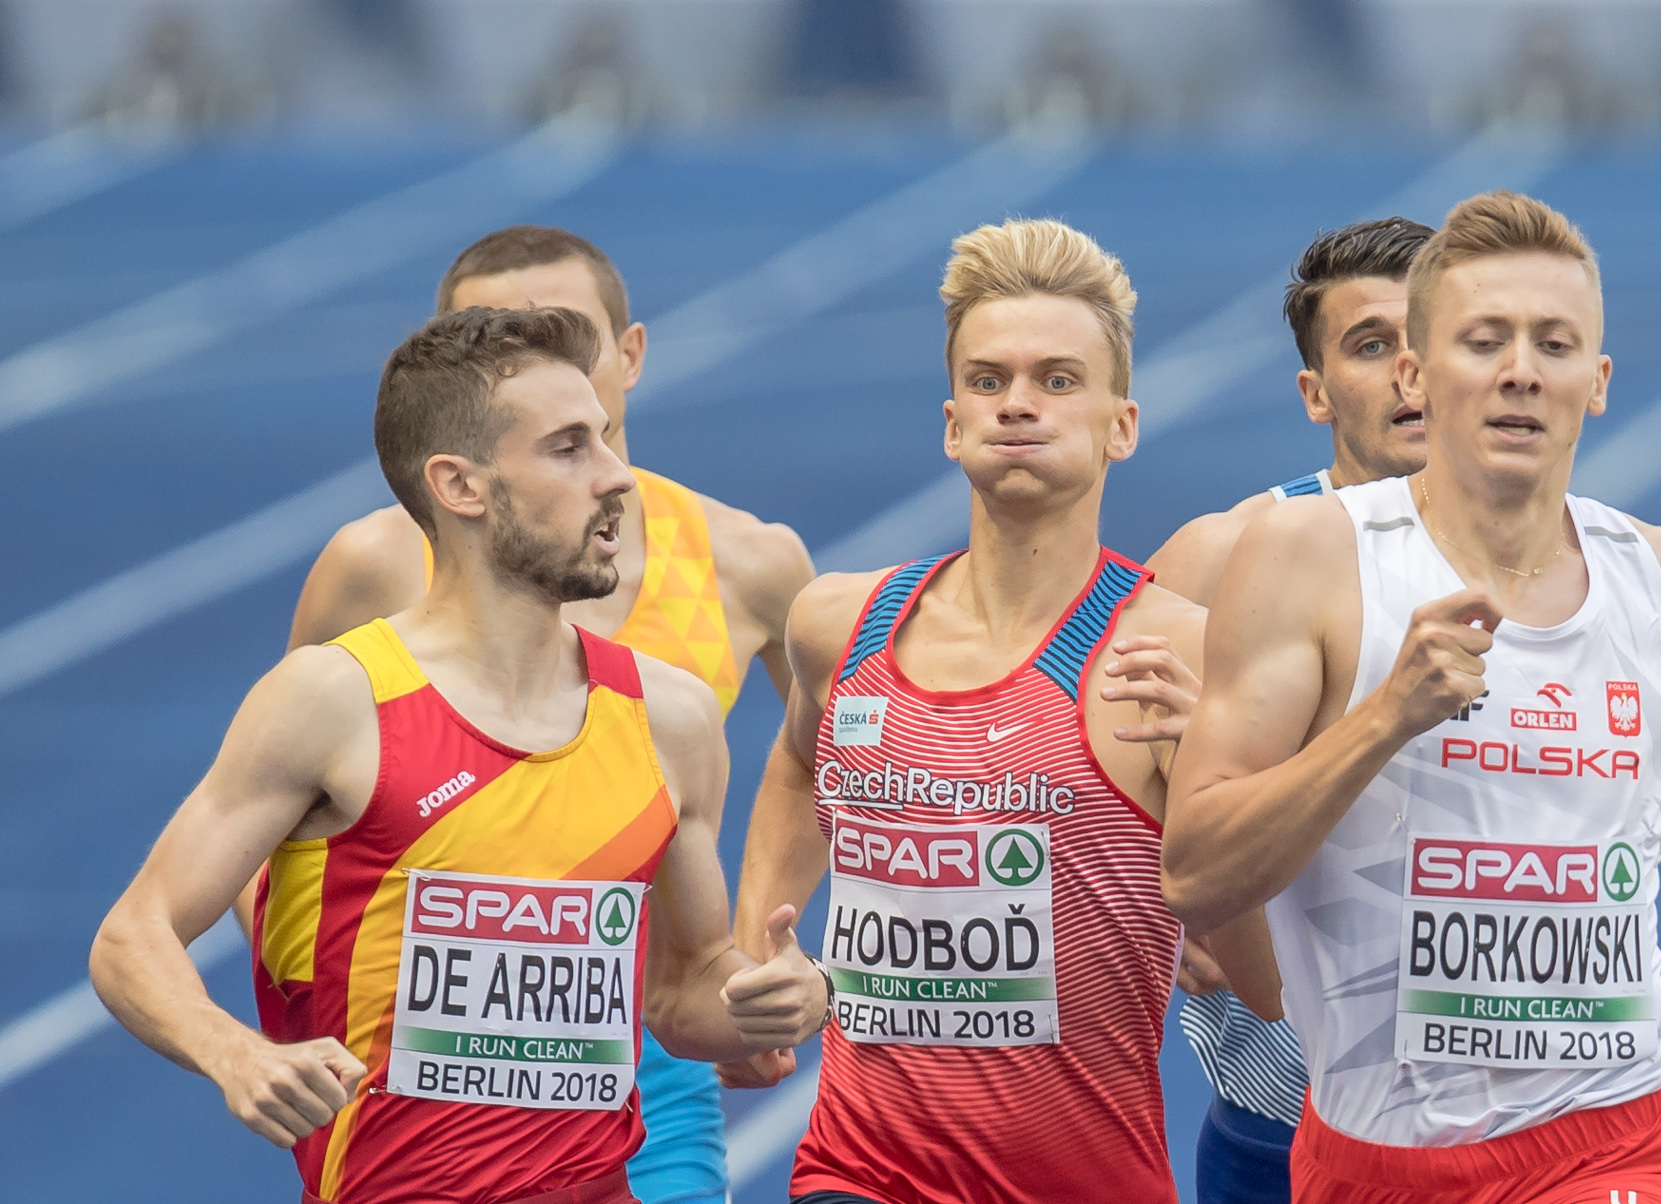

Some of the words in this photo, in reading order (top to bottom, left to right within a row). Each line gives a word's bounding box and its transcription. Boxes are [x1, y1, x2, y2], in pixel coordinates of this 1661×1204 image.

[839, 711, 867, 725] ČESKÁ
[1514, 712, 1573, 728] ORLEN
[1441, 738, 1639, 779] POLSKA
[836, 828, 976, 880] SPAR
[1417, 847, 1596, 895] SPAR
[418, 886, 587, 936] SPAR
[831, 903, 1040, 971] HODBOĎ
[1409, 911, 1643, 984] BORKOWSKI
[408, 945, 471, 1017] DE
[480, 952, 628, 1025] ARRIBA
[863, 975, 868, 993] I
[872, 977, 911, 998] RUN
[838, 1004, 942, 1038] BERLIN
[954, 1010, 1036, 1038] 2018
[1460, 997, 1466, 1014] I
[1473, 998, 1522, 1017] RUN
[455, 1036, 461, 1054] I
[468, 1038, 516, 1058] RUN
[1423, 1023, 1548, 1060] BERLIN
[1560, 1031, 1637, 1060] 2018
[416, 1061, 541, 1100] BERLIN
[550, 1072, 618, 1102] 2018
